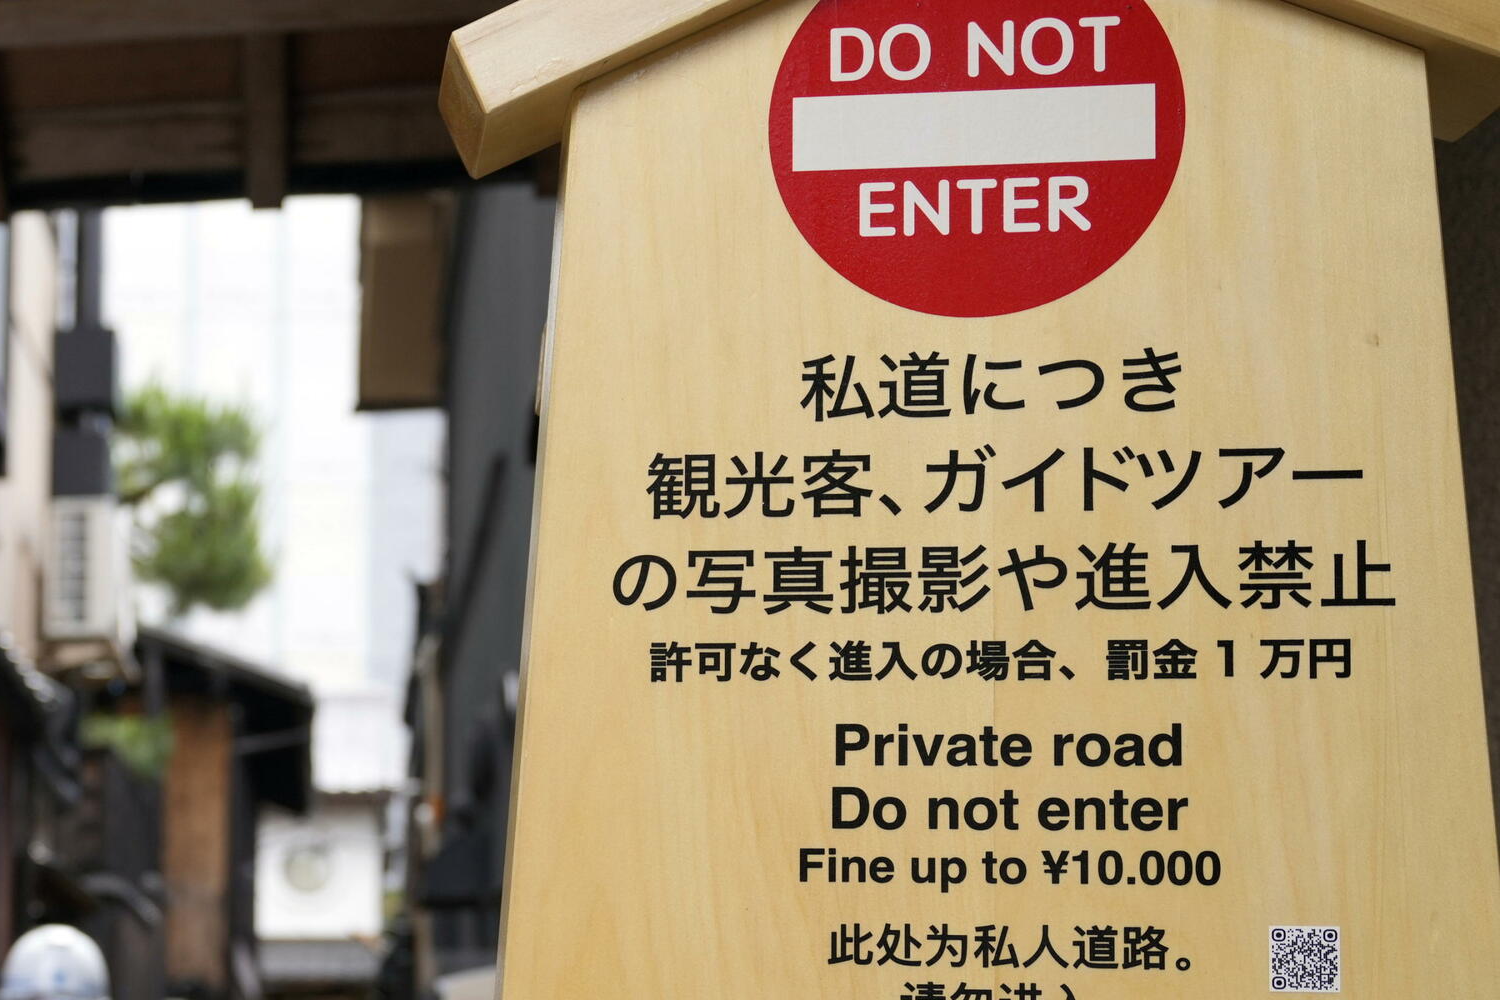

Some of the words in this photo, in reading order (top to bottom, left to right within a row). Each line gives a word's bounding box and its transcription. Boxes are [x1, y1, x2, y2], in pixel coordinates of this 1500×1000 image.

[830, 24, 931, 82] DO
[968, 16, 1120, 77] NOT
[859, 176, 1091, 237] ENTER
[800, 347, 1181, 422] 私道につき
[613, 540, 1396, 615] の写真撮影や進入禁止
[836, 724, 1032, 767] Private
[1054, 723, 1182, 767] road
[832, 787, 906, 830] Do
[929, 790, 1019, 830] not
[1038, 790, 1188, 831] enter
[800, 848, 894, 883] Fine
[912, 857, 967, 893] up
[982, 851, 1027, 884] to
[1041, 850, 1221, 886] ¥10.000
[828, 923, 1190, 971] 此处为私人道路。
